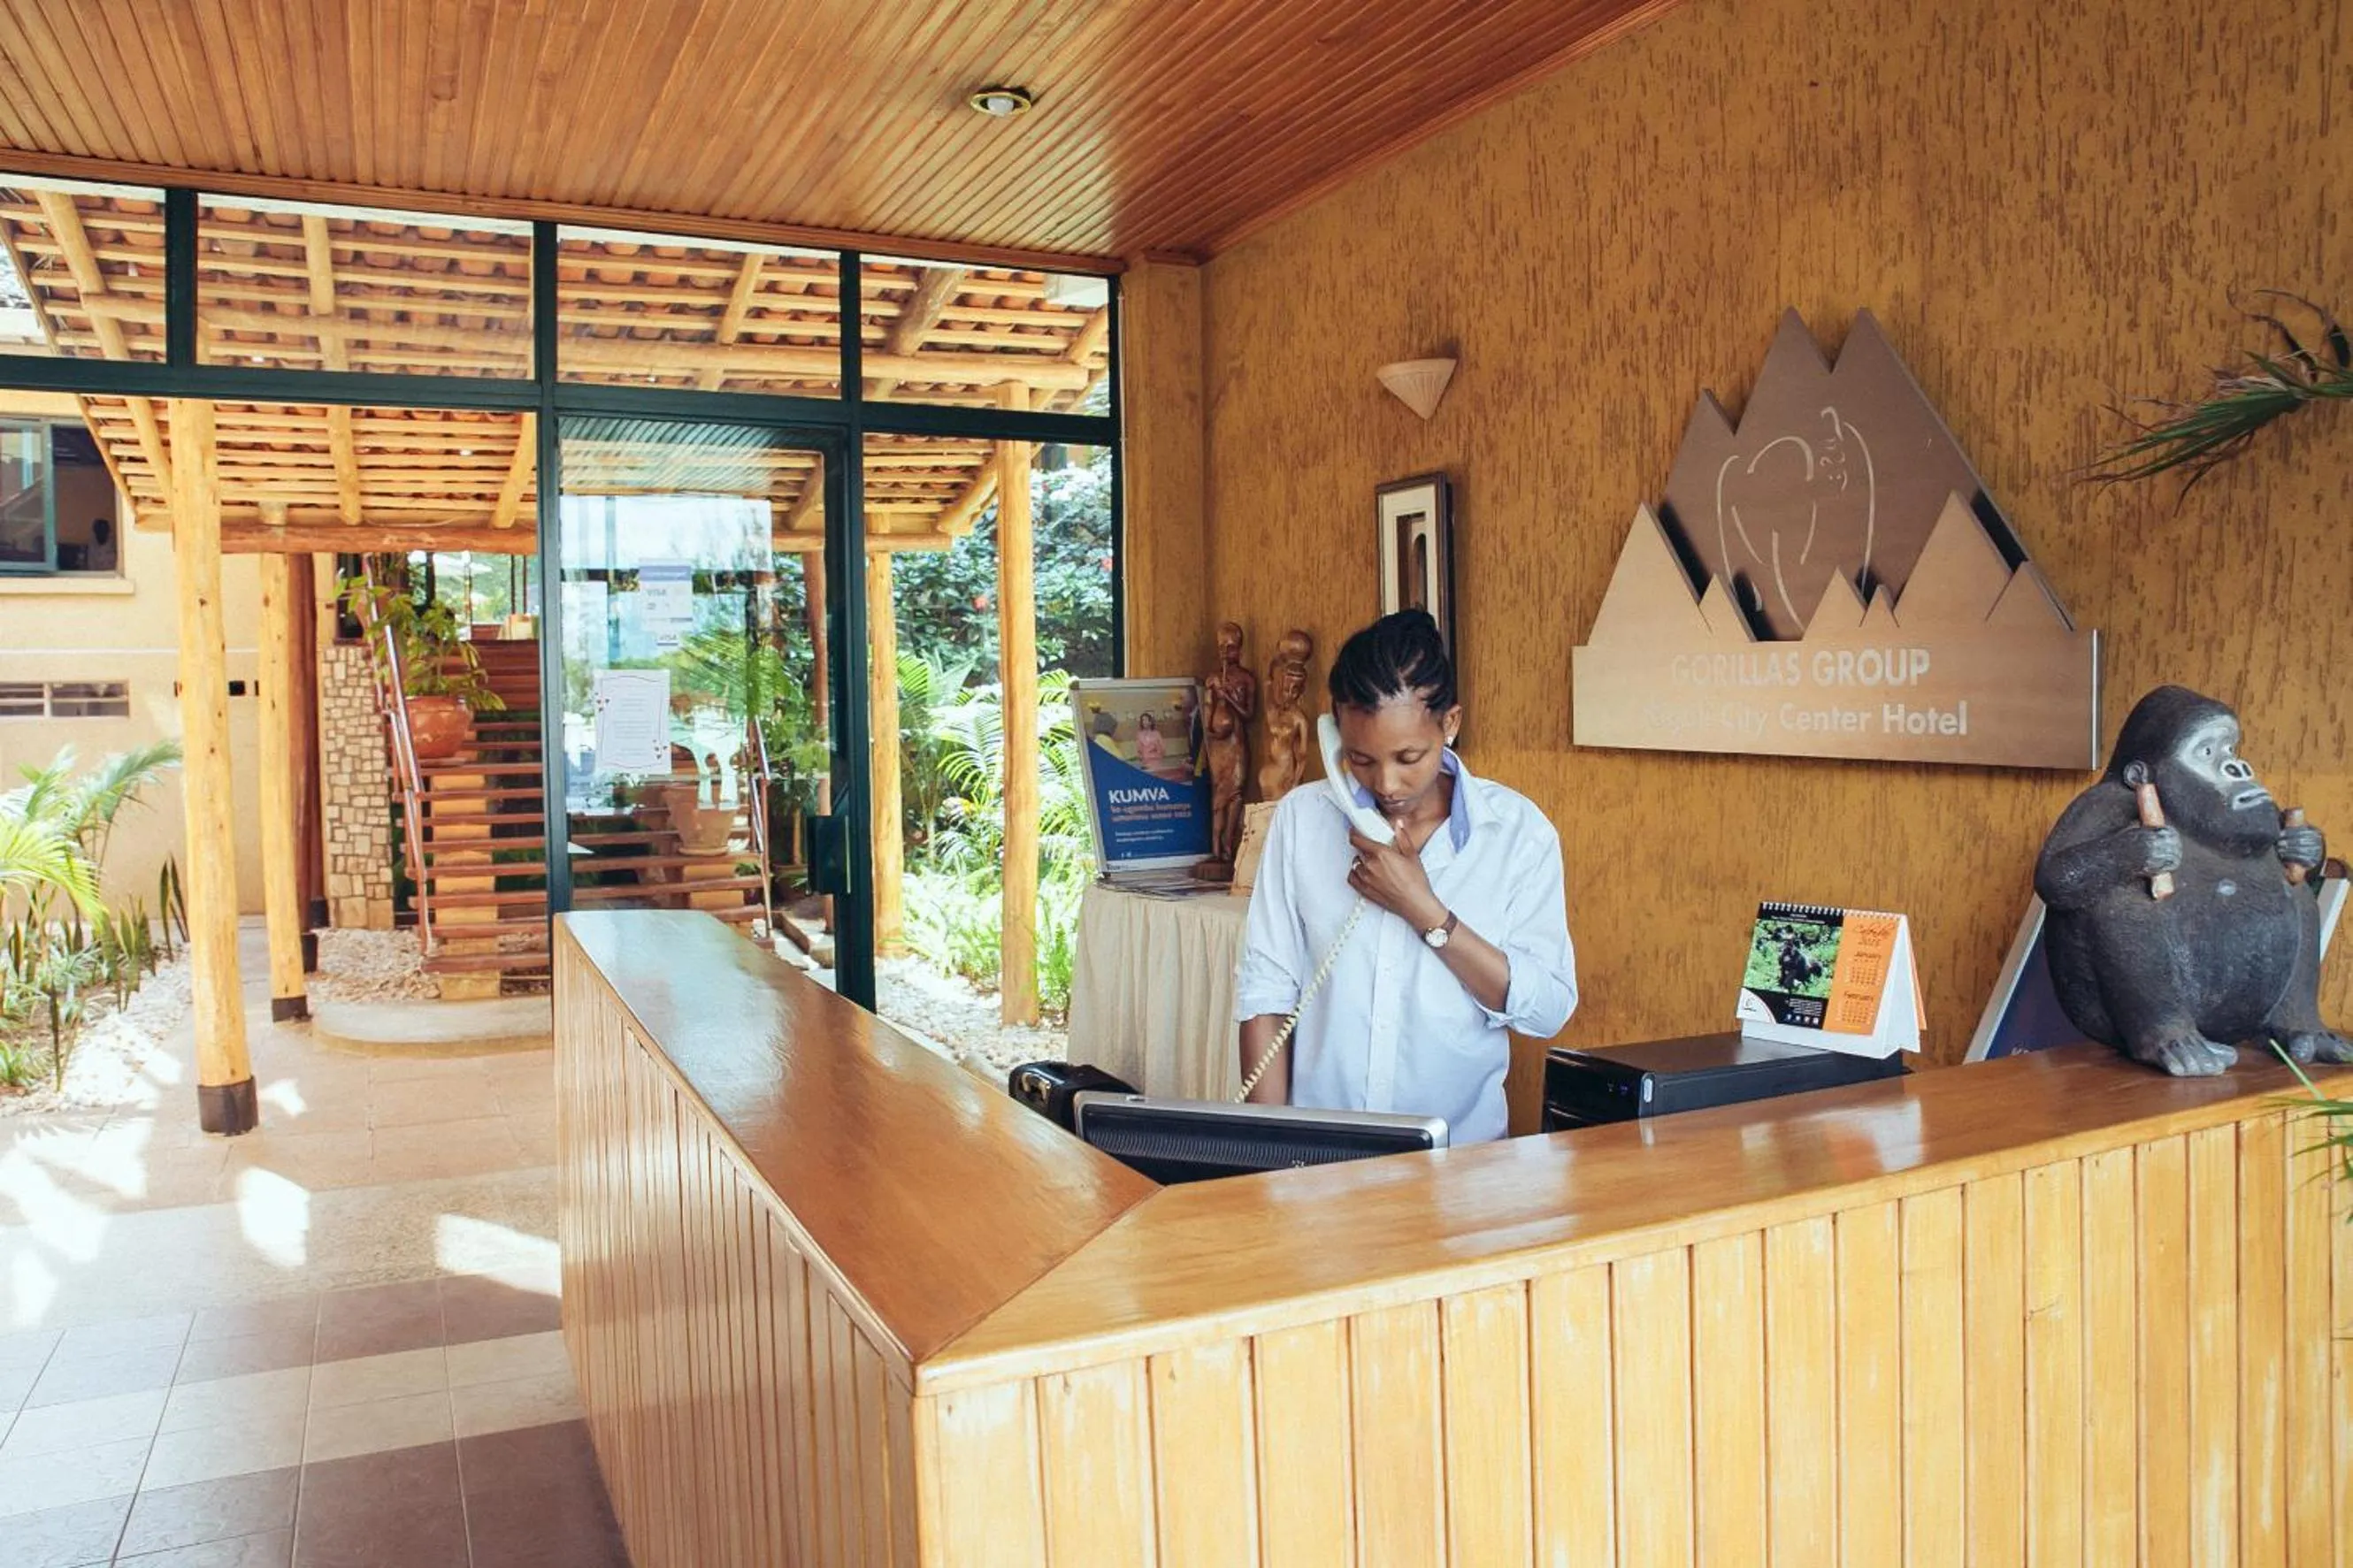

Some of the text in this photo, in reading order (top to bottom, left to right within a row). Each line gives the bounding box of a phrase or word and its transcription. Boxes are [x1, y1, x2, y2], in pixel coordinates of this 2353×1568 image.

[1672, 647, 1930, 687] GORILLAS GROUP
[1779, 701, 1872, 732] Center
[1882, 700, 1968, 736] Hotel
[1108, 786, 1170, 804] KUMVA
